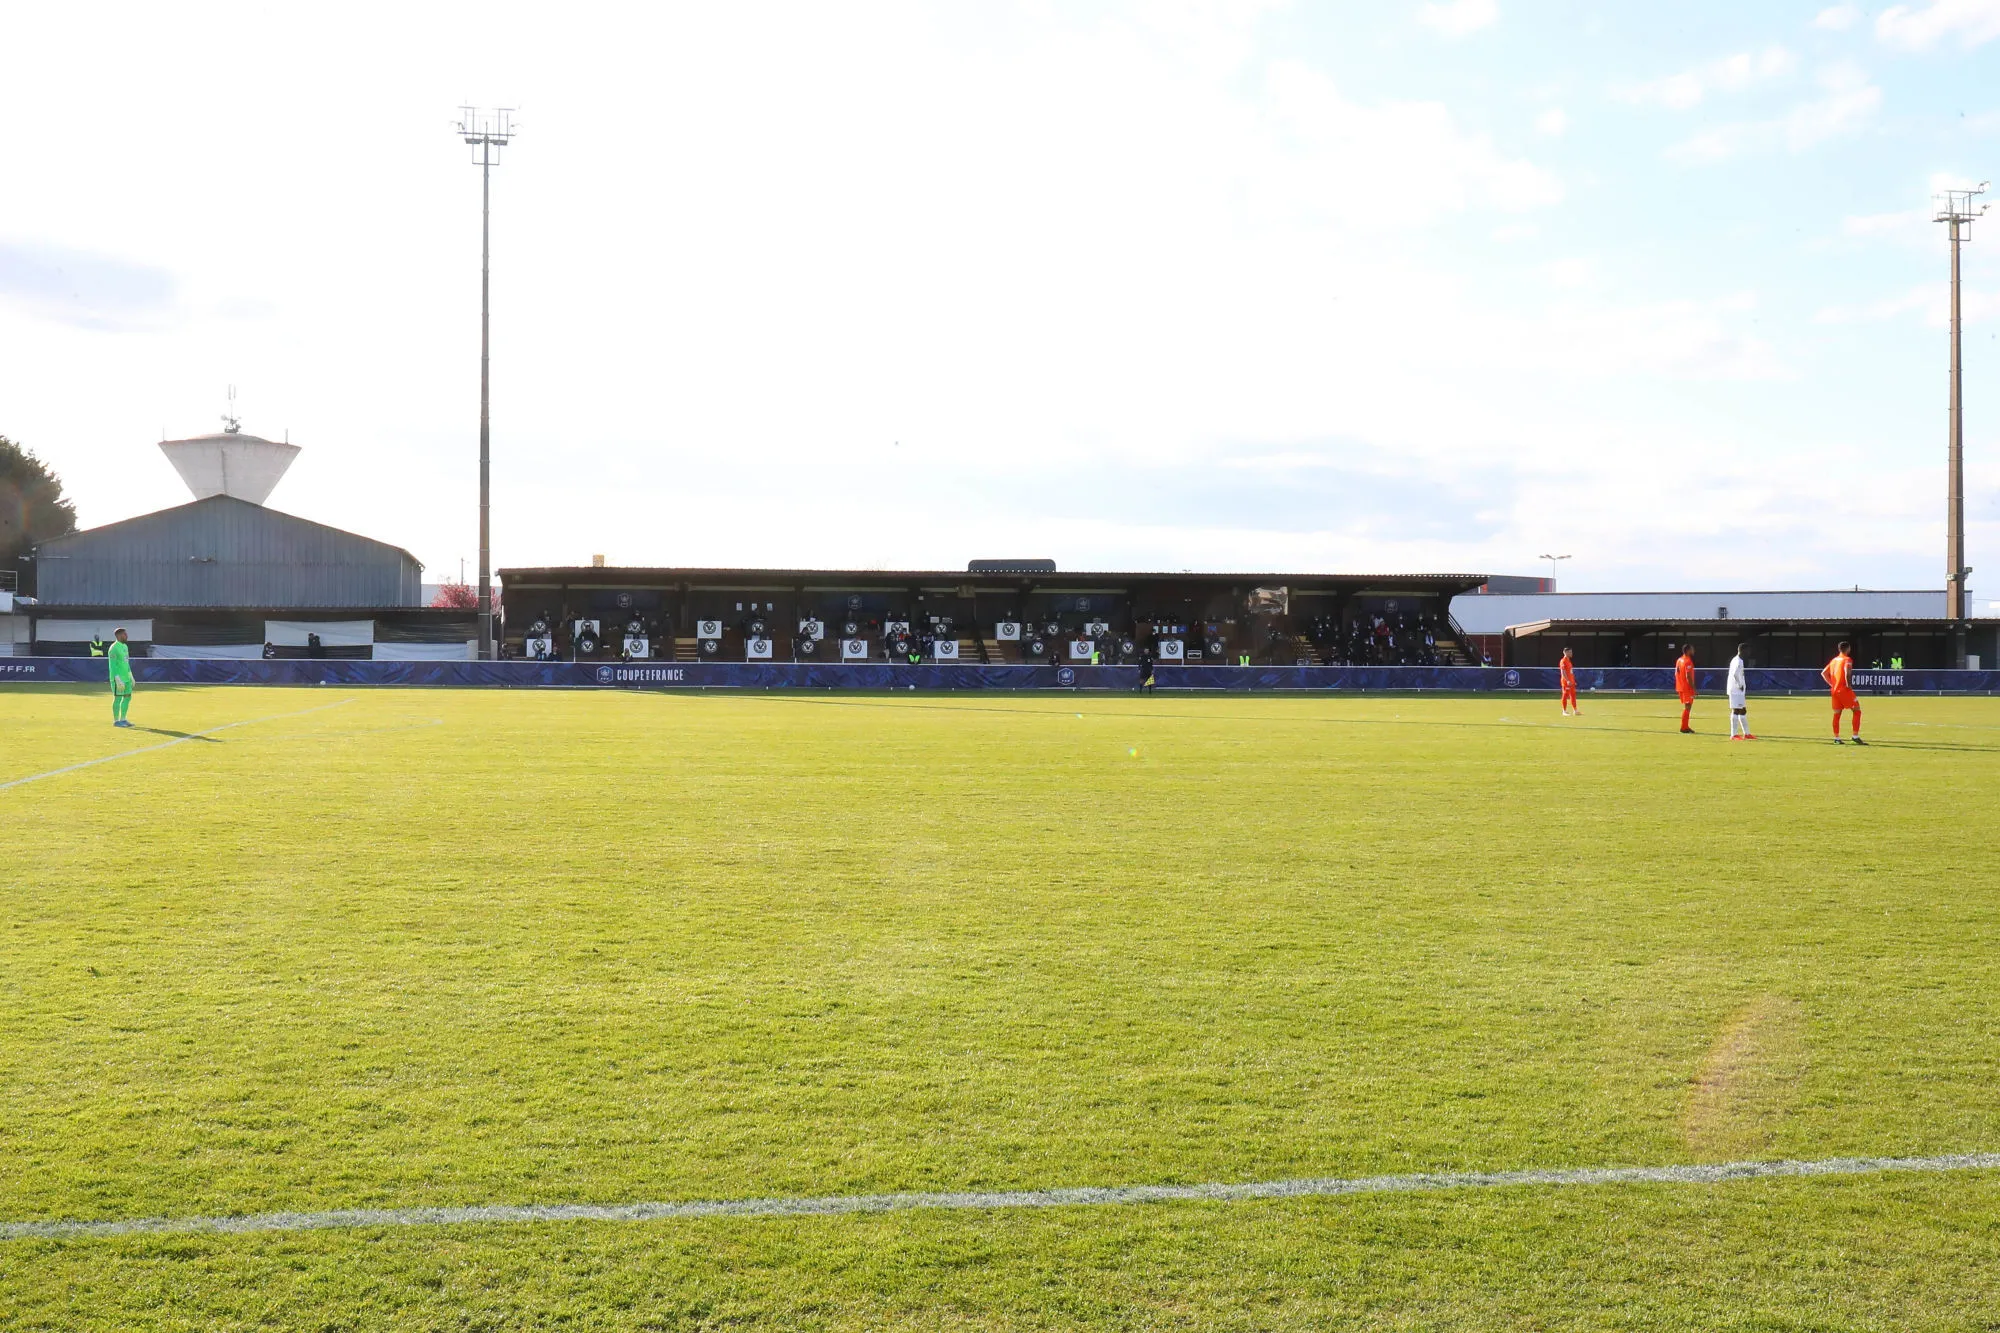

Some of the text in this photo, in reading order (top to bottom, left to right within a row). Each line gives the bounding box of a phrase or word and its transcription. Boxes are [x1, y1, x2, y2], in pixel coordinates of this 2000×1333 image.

[617, 669, 645, 680] COUPE
[651, 669, 684, 680] FRANCE
[1851, 674, 1873, 686] COUPE
[1878, 675, 1904, 686] FRANCE
